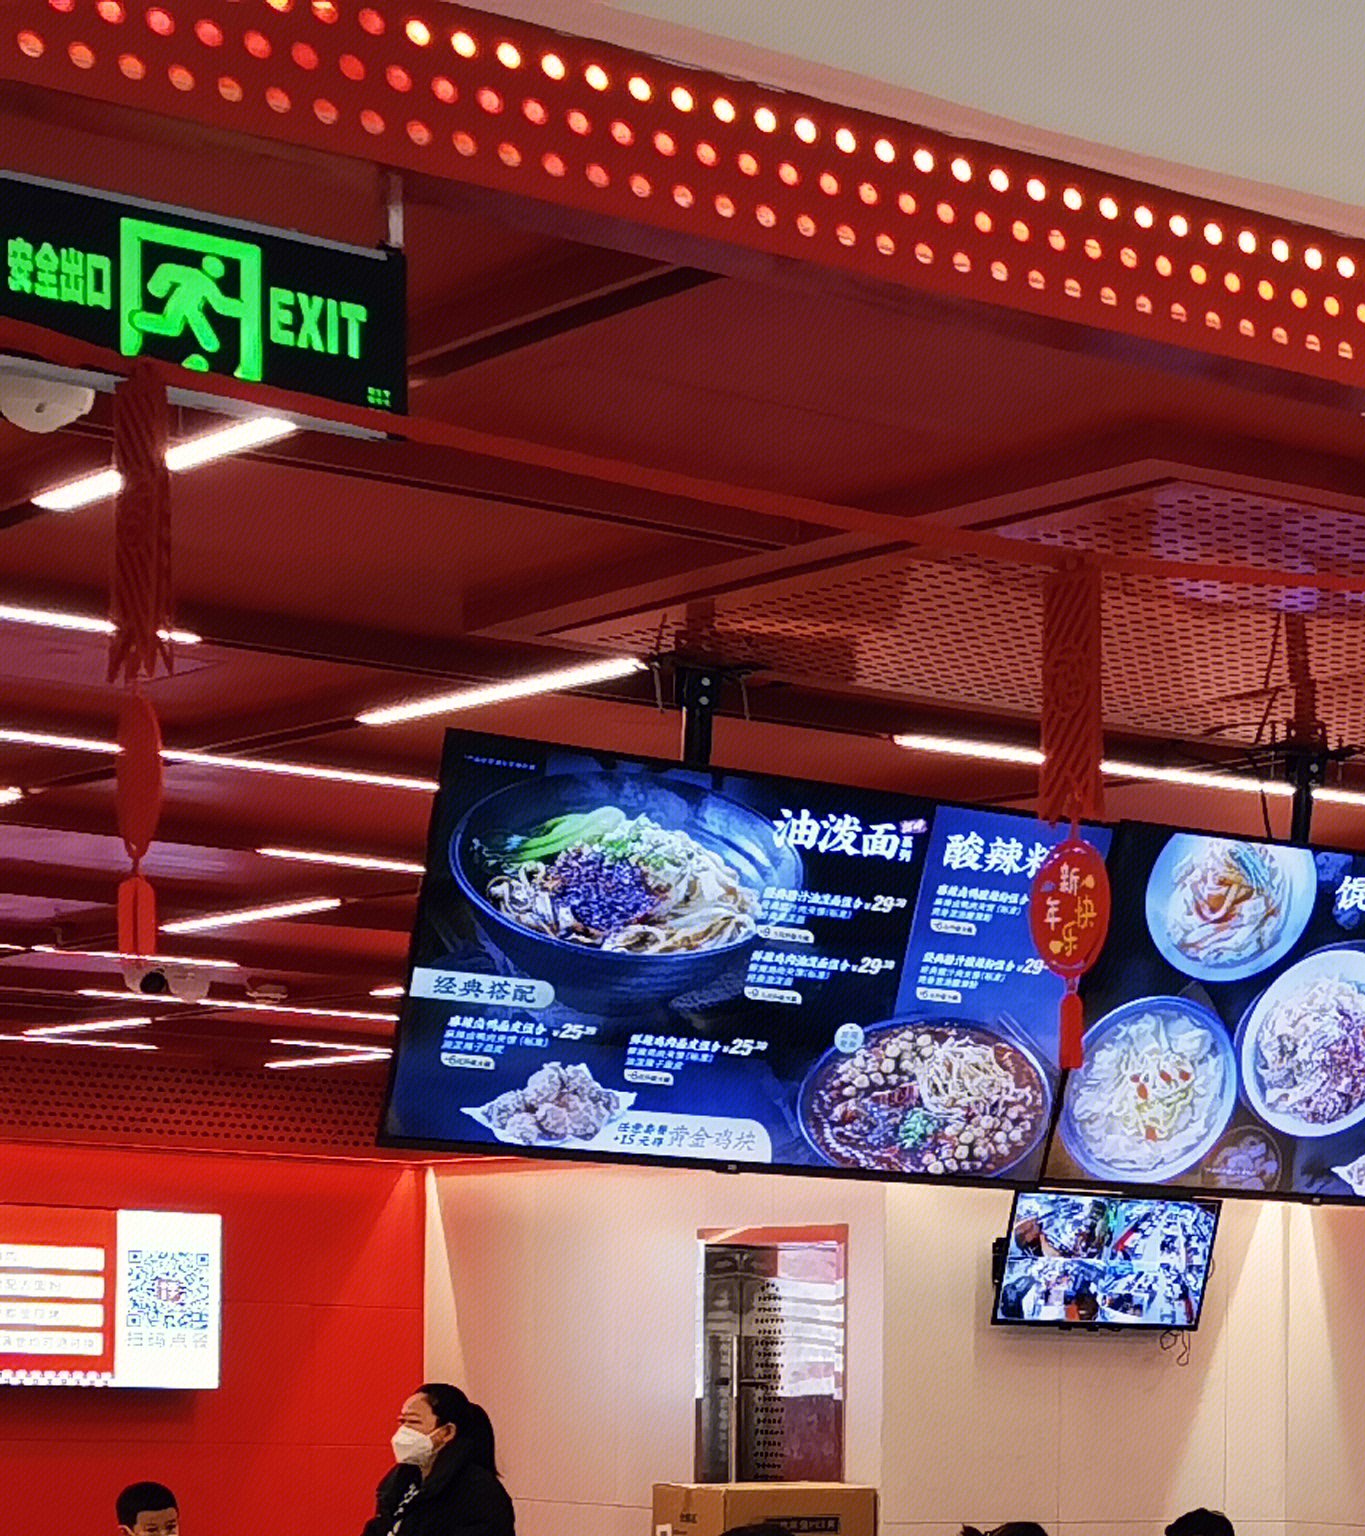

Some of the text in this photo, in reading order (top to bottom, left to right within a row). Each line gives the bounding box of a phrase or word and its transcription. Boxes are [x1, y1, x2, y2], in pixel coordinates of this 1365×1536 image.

[7, 237, 111, 310] 安全出口
[270, 286, 367, 359] EXIT
[773, 808, 900, 860] 油泼面
[433, 975, 537, 1003] 经典搭配
